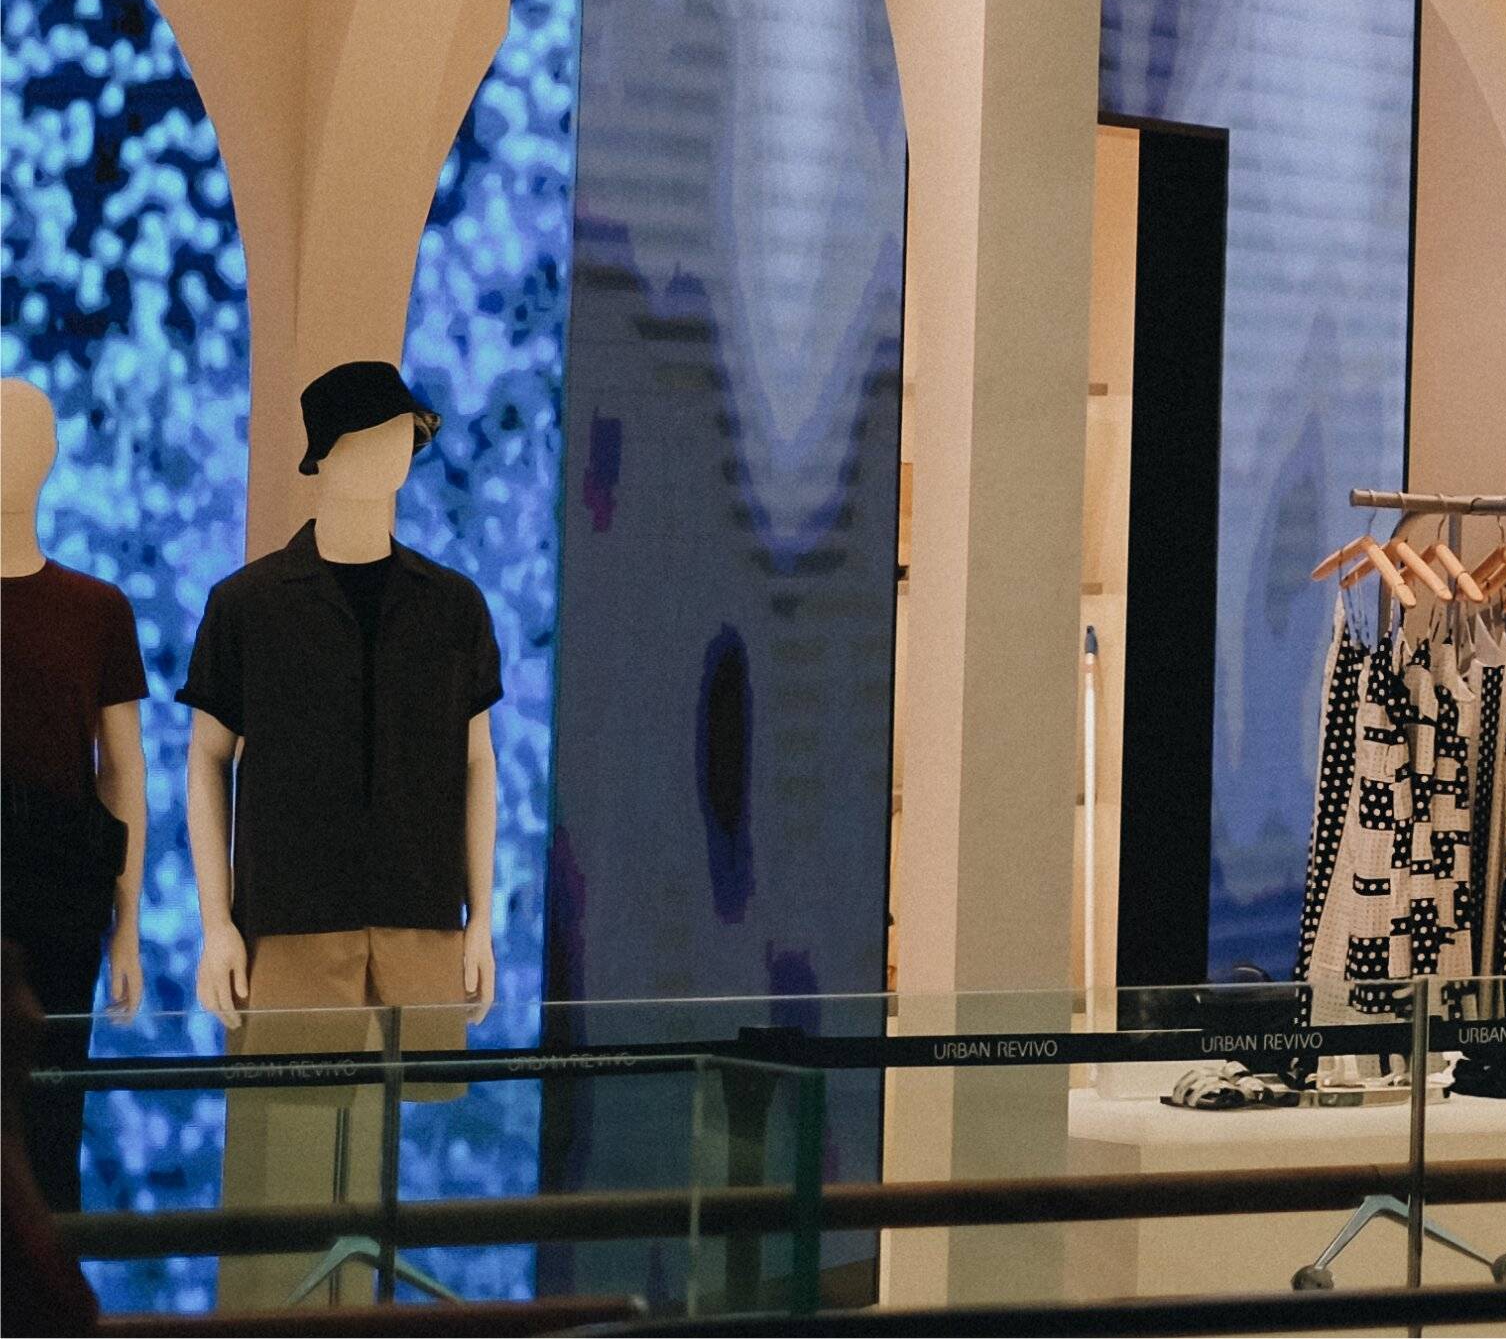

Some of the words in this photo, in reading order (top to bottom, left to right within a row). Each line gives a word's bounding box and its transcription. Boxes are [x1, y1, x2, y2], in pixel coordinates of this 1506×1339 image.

[934, 1041, 991, 1060] URBAN
[997, 1040, 1058, 1058] REVIVO
[1201, 1034, 1258, 1053] URBAN
[1263, 1032, 1323, 1050] REVIVO
